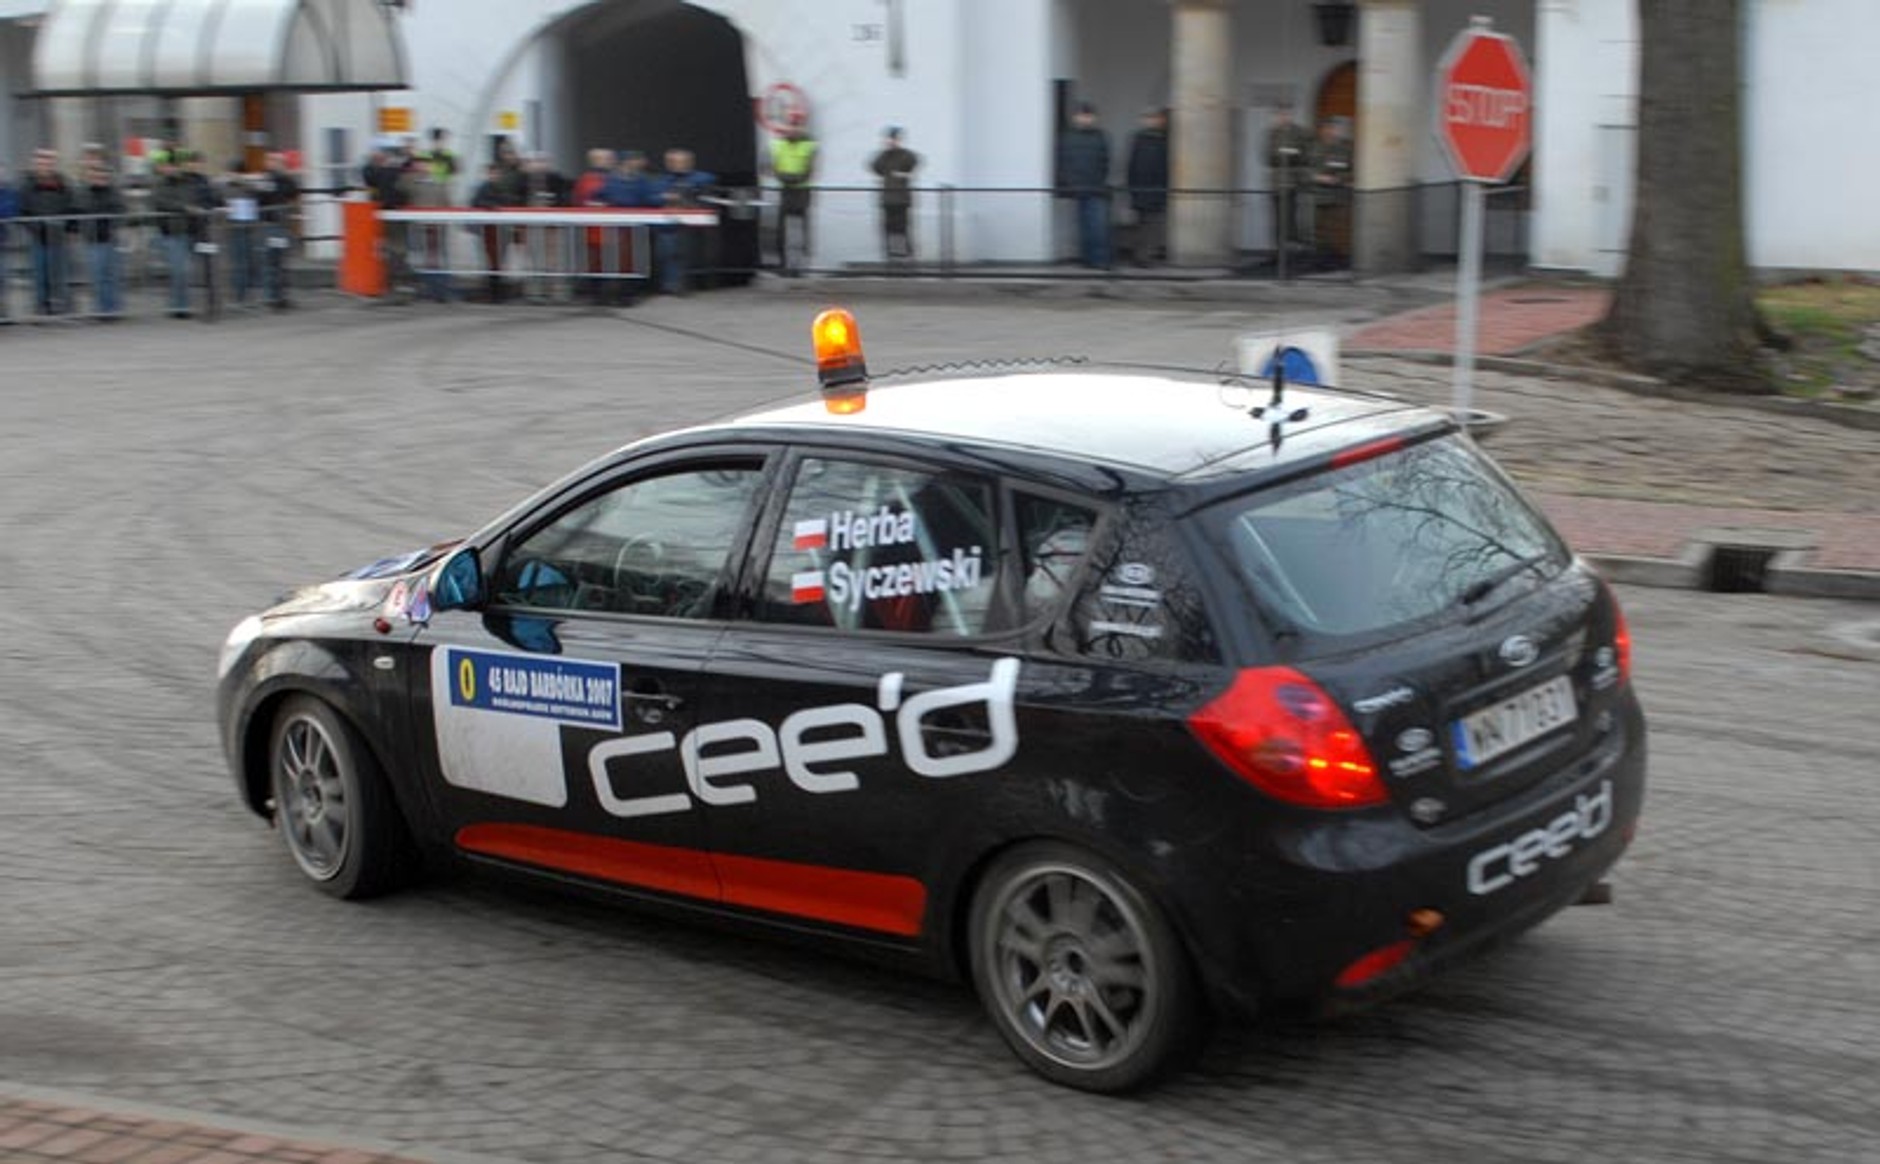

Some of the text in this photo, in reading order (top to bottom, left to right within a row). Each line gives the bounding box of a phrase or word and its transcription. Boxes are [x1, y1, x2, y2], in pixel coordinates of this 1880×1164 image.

[1446, 84, 1527, 132] STOP
[830, 505, 916, 550] Herba
[829, 546, 982, 612] Syczewski
[488, 666, 502, 694] 45
[503, 667, 528, 697] RAJD
[586, 676, 613, 706] 2007
